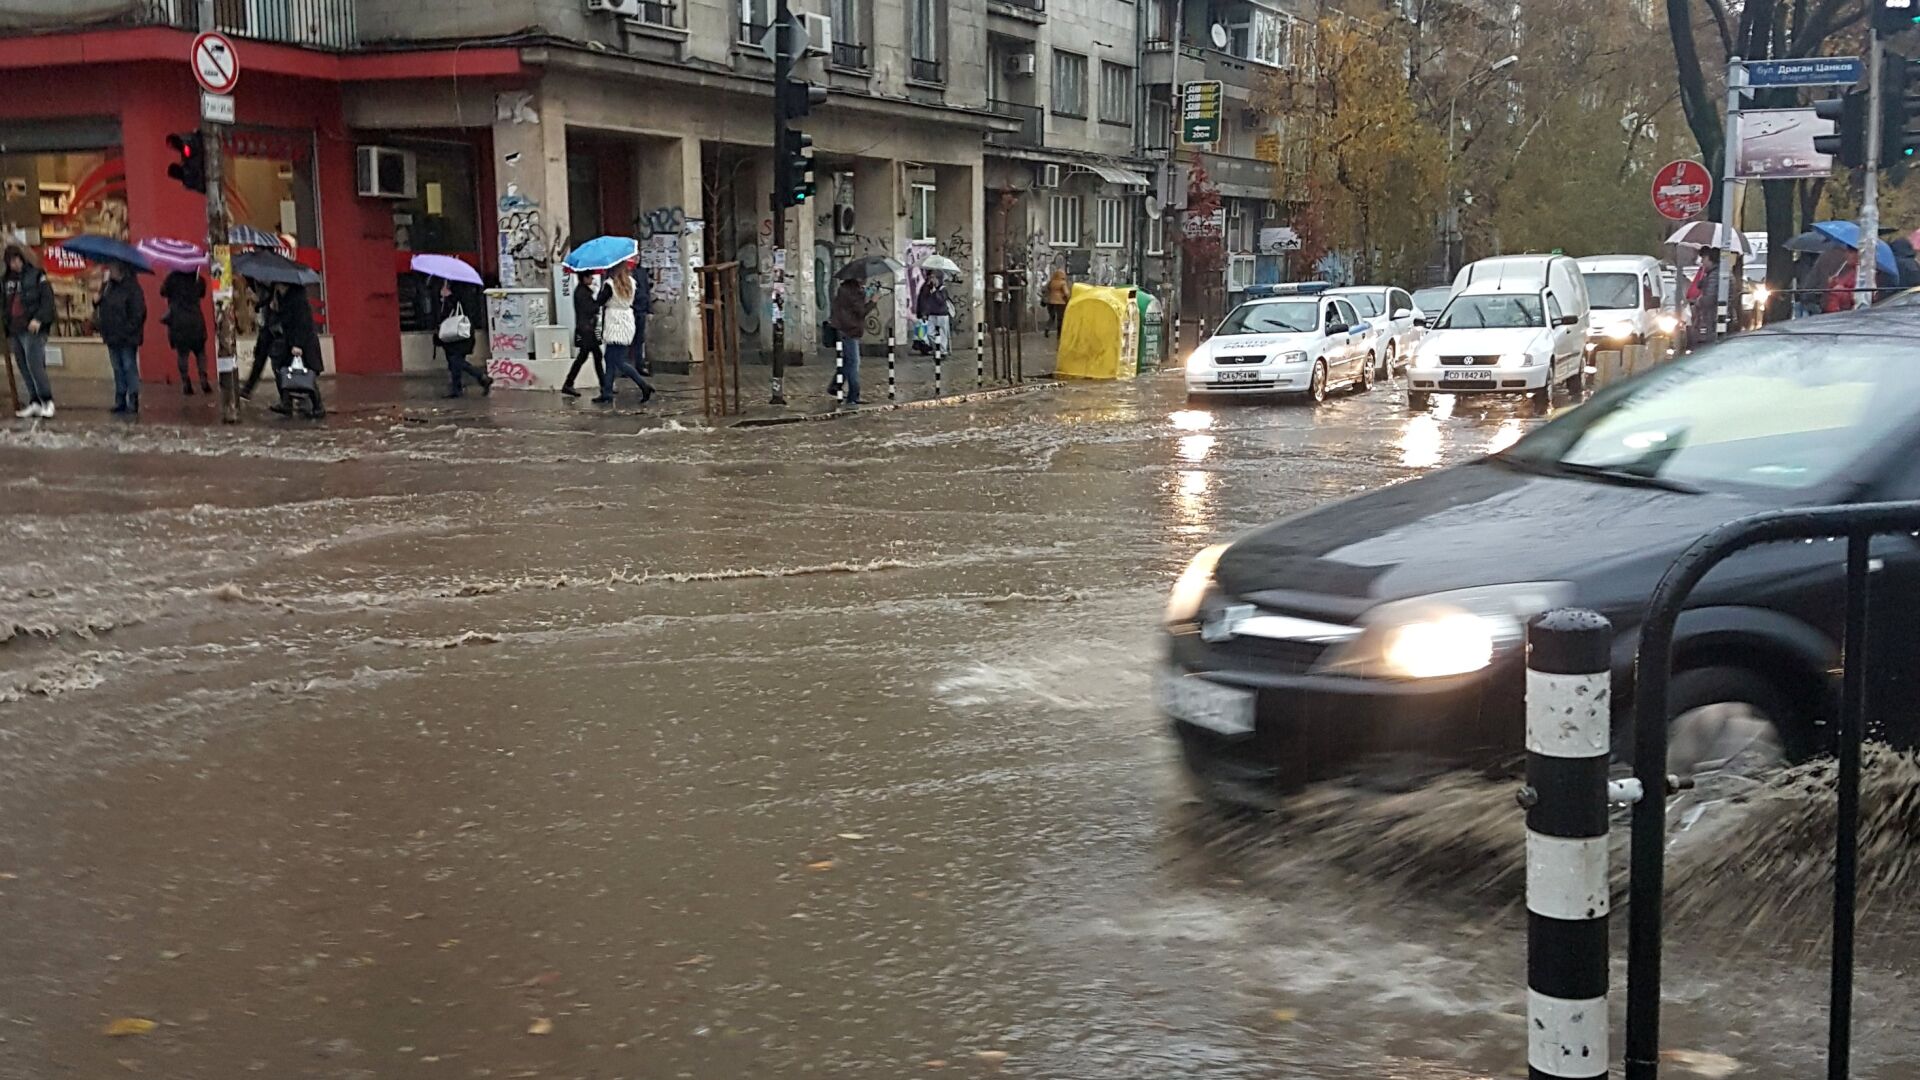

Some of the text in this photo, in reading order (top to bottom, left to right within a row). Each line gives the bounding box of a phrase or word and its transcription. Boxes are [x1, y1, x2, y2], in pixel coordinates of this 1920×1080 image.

[1778, 65, 1813, 74] Драган
[1815, 63, 1853, 73] Цанков
[1231, 372, 1247, 380] 6754
